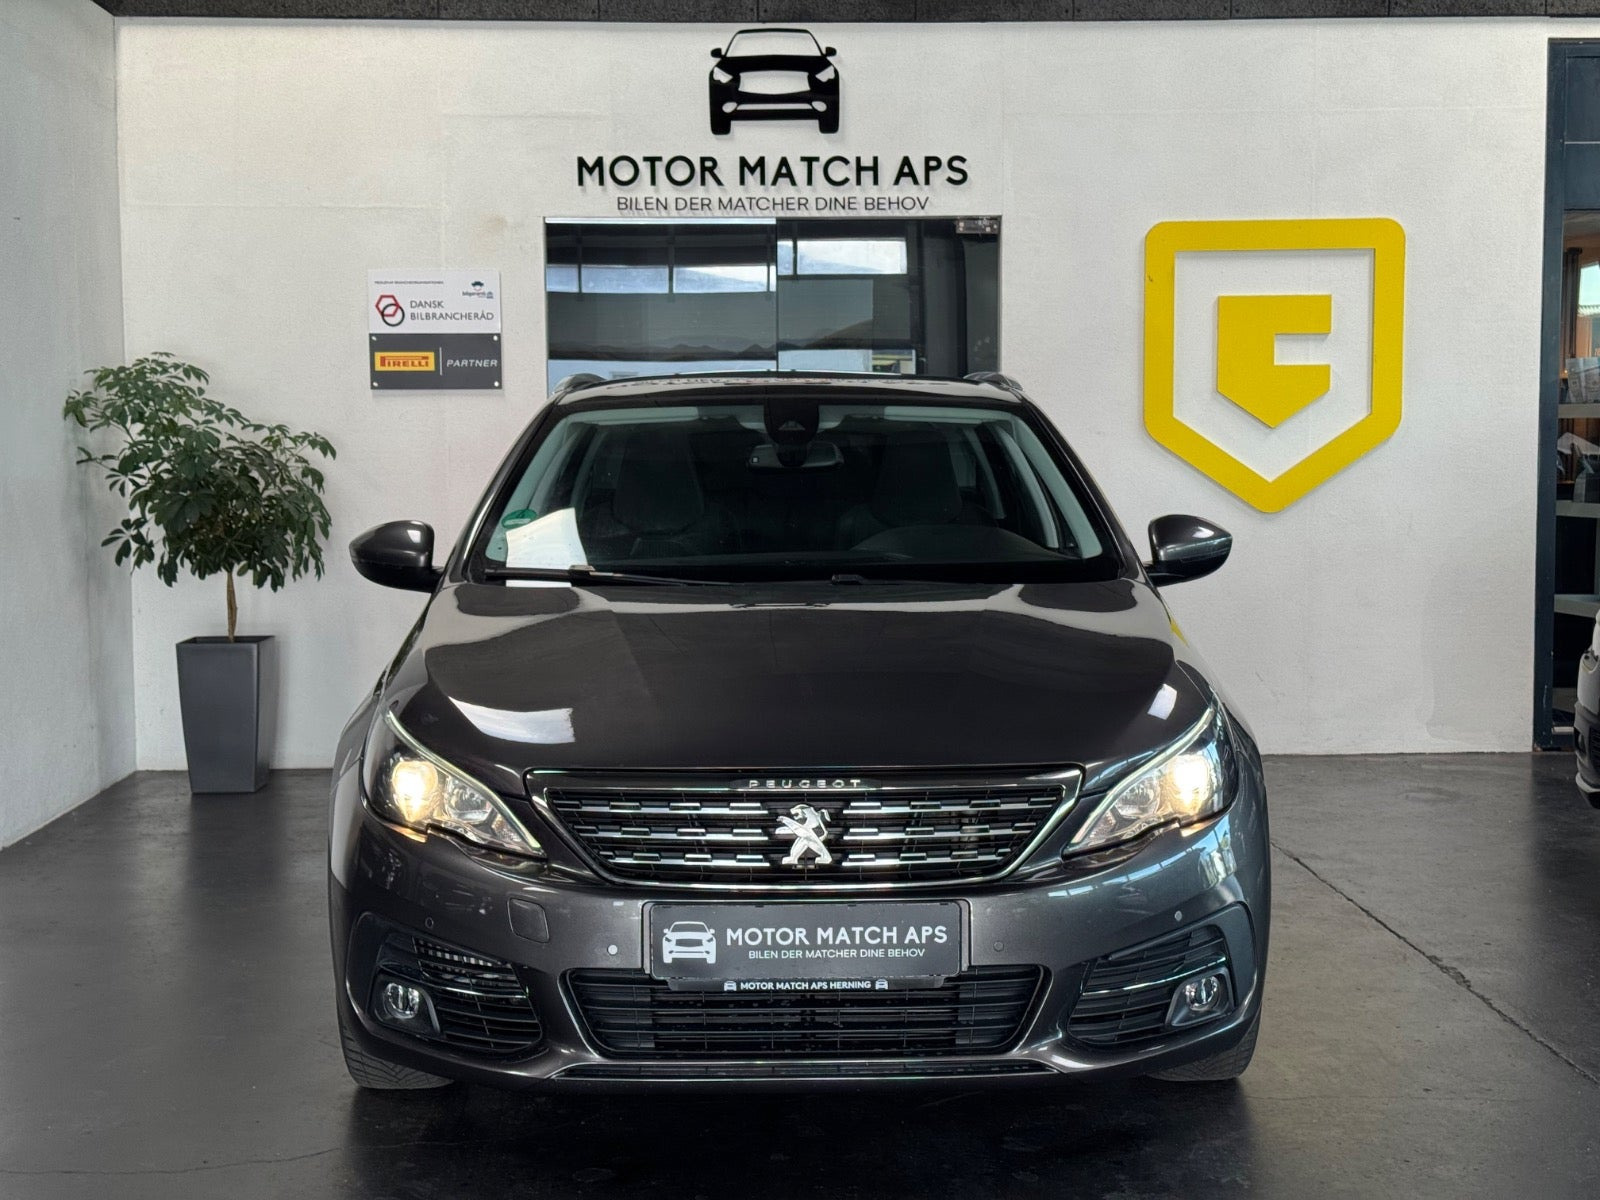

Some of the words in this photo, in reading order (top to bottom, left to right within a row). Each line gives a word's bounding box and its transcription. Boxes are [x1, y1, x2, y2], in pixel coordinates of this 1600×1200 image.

[577, 155, 724, 187] MOTOR
[739, 155, 879, 187] MATCH
[893, 155, 969, 186] APS
[617, 197, 668, 211] BILEN
[675, 197, 712, 211] DER
[718, 196, 809, 211] MATCHER
[815, 196, 857, 211] DINE
[864, 196, 929, 211] BEHOV
[410, 300, 444, 309] DANSK
[410, 310, 494, 321] BILBRANCHERÅD
[446, 359, 498, 368] PARTNER
[748, 779, 862, 789] PEUGEOT
[726, 927, 810, 946] MOTOR
[816, 926, 898, 946] MATCH
[903, 925, 948, 945] APS
[748, 950, 779, 960] BILEN
[781, 950, 803, 959] DER
[805, 949, 858, 959] MATCHER
[860, 949, 885, 958] DINE
[887, 948, 926, 958] BEHOV
[740, 981, 774, 990] MOTOR
[776, 981, 809, 990] MATCH
[810, 981, 828, 990] APS
[829, 980, 871, 990] HERNING
